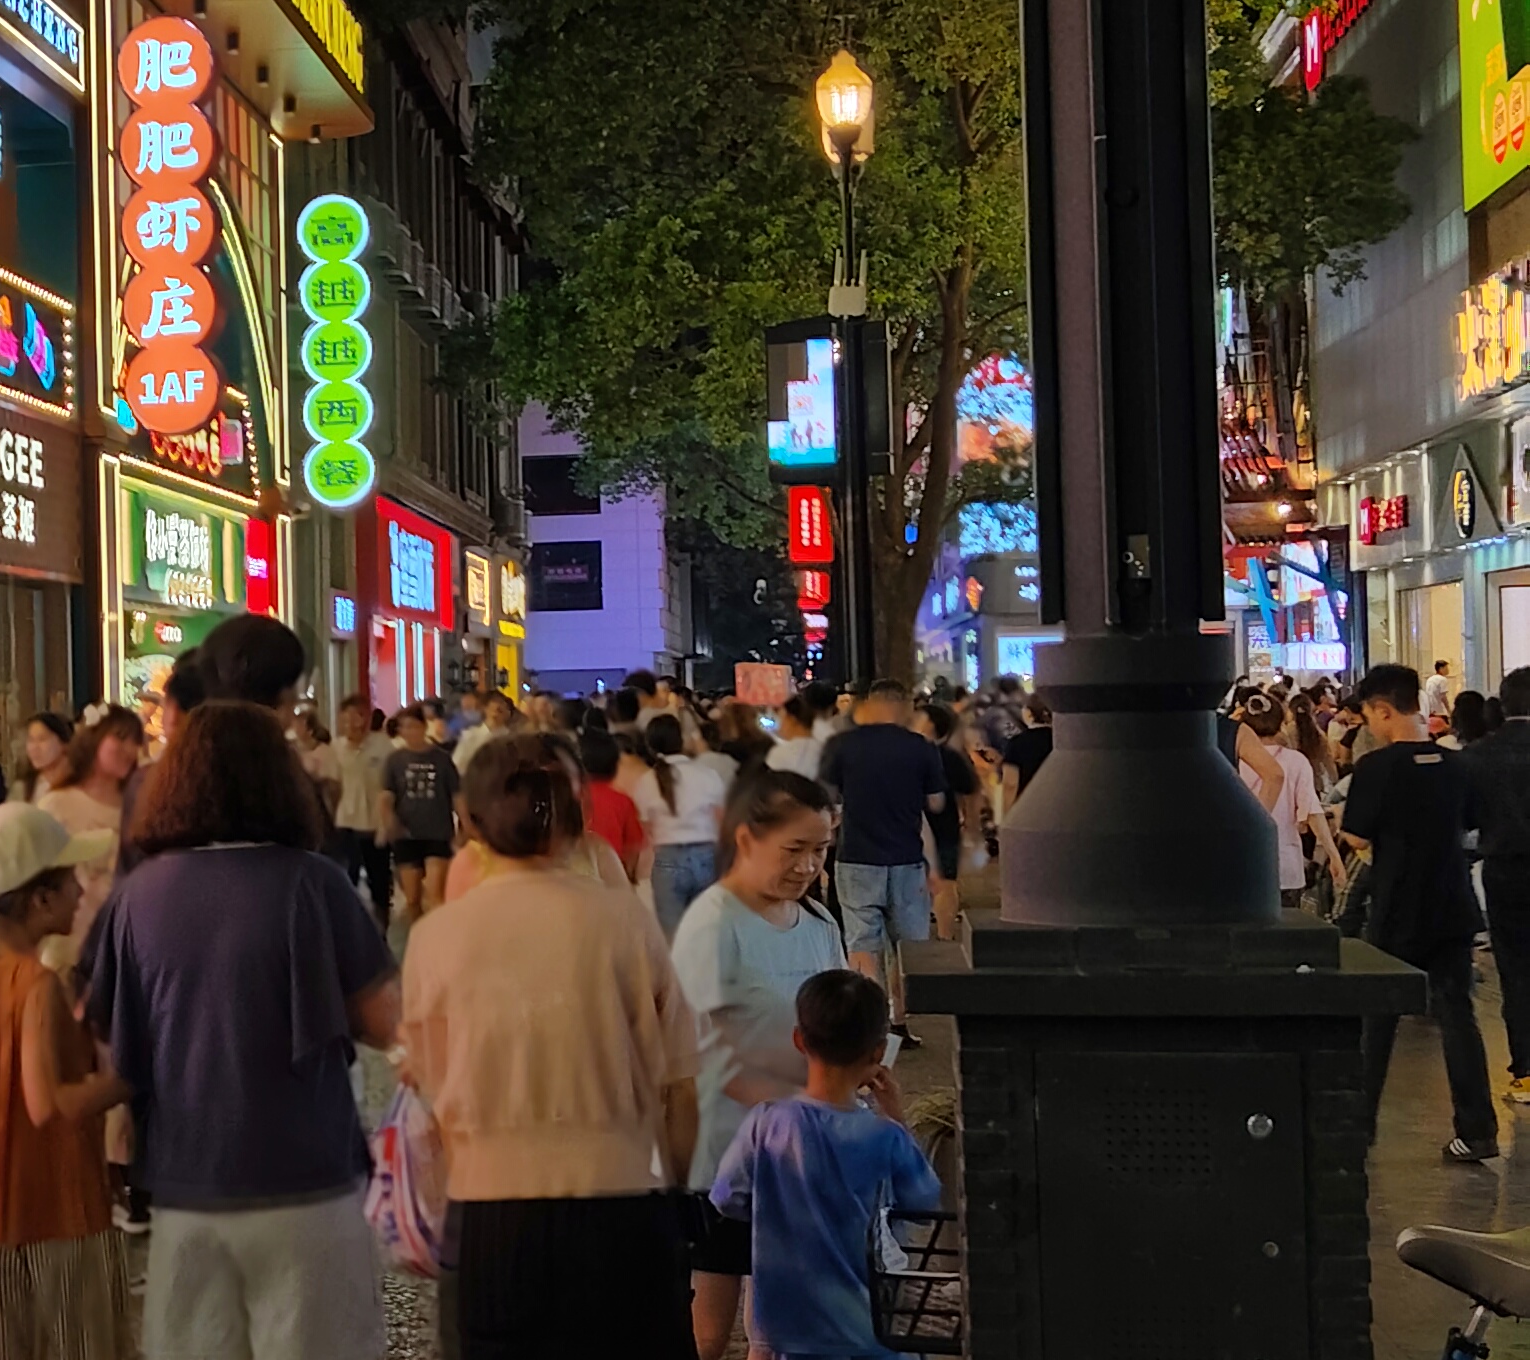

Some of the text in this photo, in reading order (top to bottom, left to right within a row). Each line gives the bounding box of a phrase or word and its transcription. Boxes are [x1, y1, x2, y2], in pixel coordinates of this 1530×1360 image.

[134, 38, 202, 340] 肥肥虾庄
[138, 369, 206, 406] 1AF
